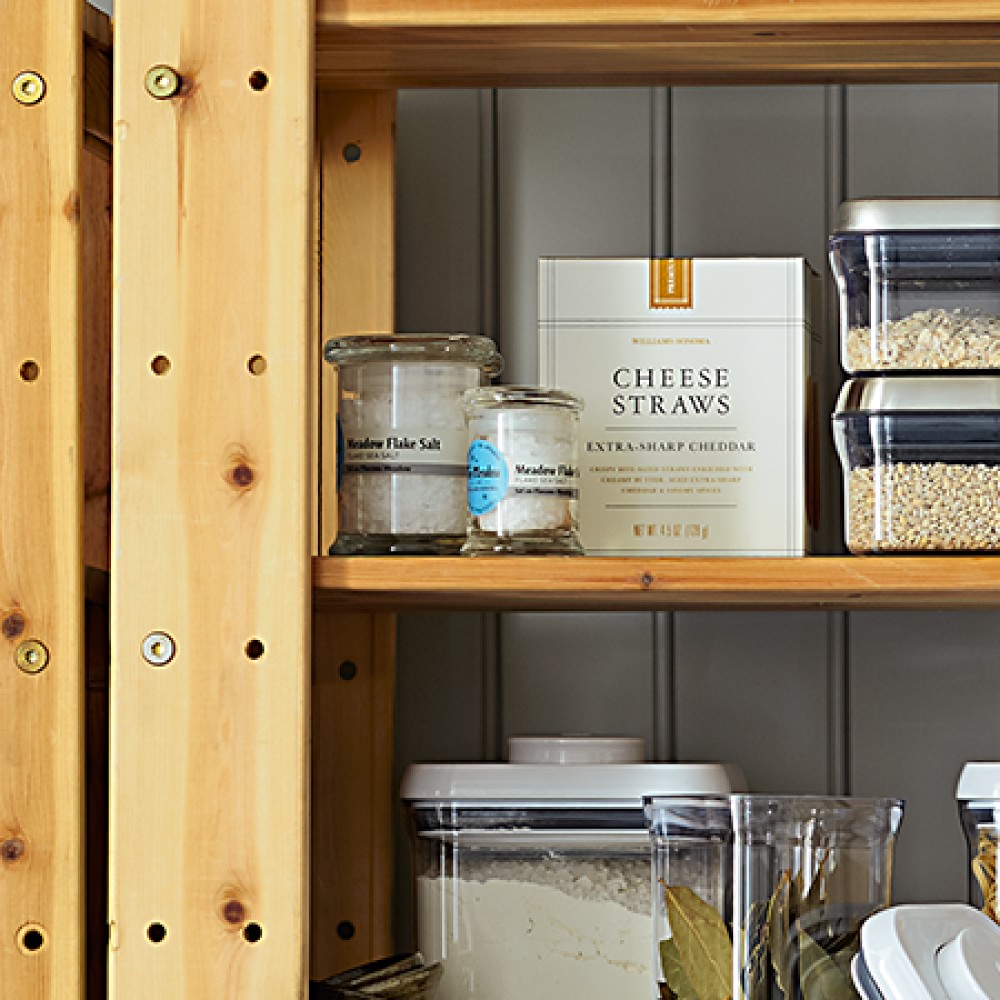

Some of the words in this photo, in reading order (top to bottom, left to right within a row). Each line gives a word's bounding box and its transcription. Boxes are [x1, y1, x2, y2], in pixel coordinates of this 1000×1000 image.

[612, 367, 731, 389] CHEESE
[612, 394, 731, 416] STRAWS
[386, 436, 416, 450] Flake
[419, 437, 441, 451] Salt
[586, 441, 685, 452] EXTRA-SHARP
[688, 441, 757, 452] CHEDDAR
[515, 463, 556, 476] Meadow
